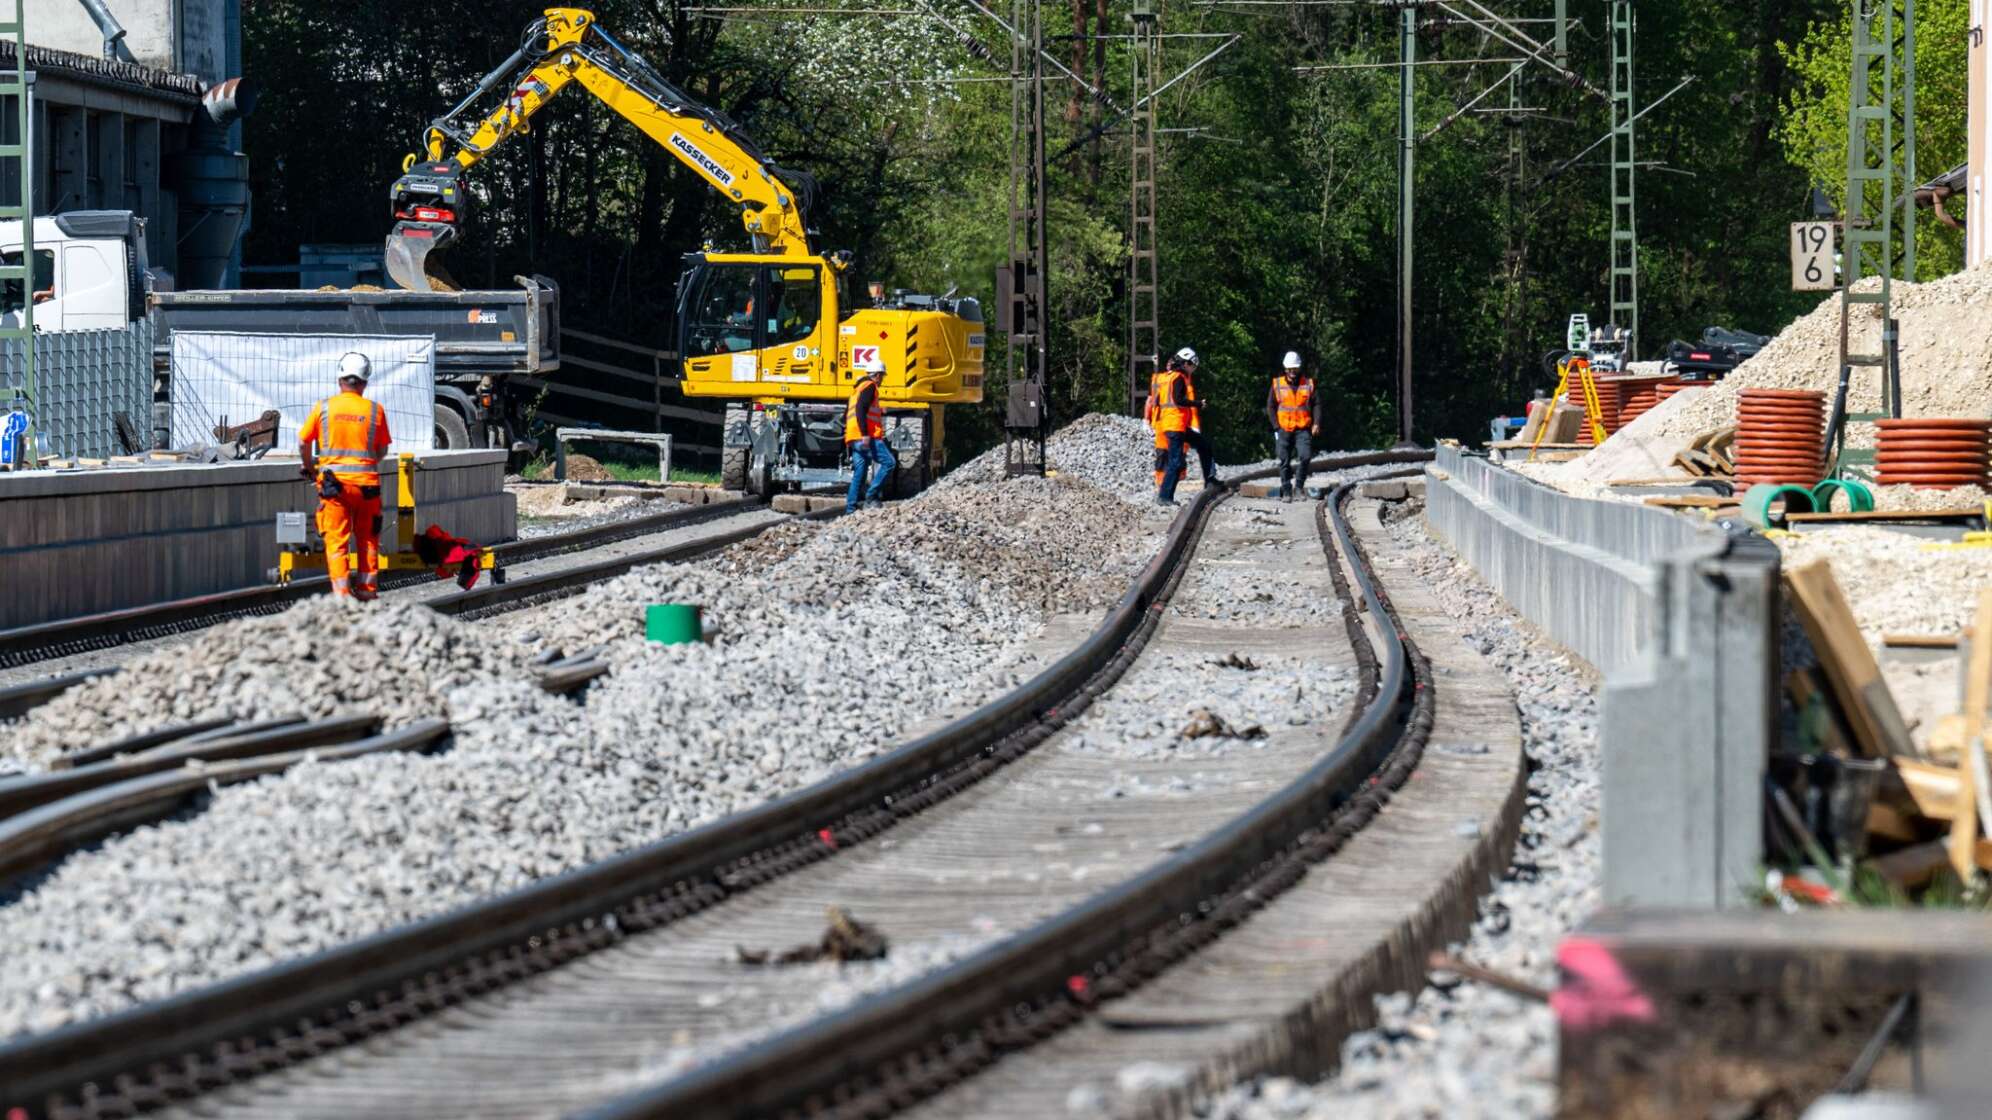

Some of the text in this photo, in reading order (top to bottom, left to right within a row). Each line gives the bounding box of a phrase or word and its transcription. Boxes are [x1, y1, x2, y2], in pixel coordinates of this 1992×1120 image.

[672, 135, 731, 185] KASSECKER
[1797, 225, 1827, 253] 19
[1805, 256, 1822, 283] 6
[796, 347, 807, 358] 20
